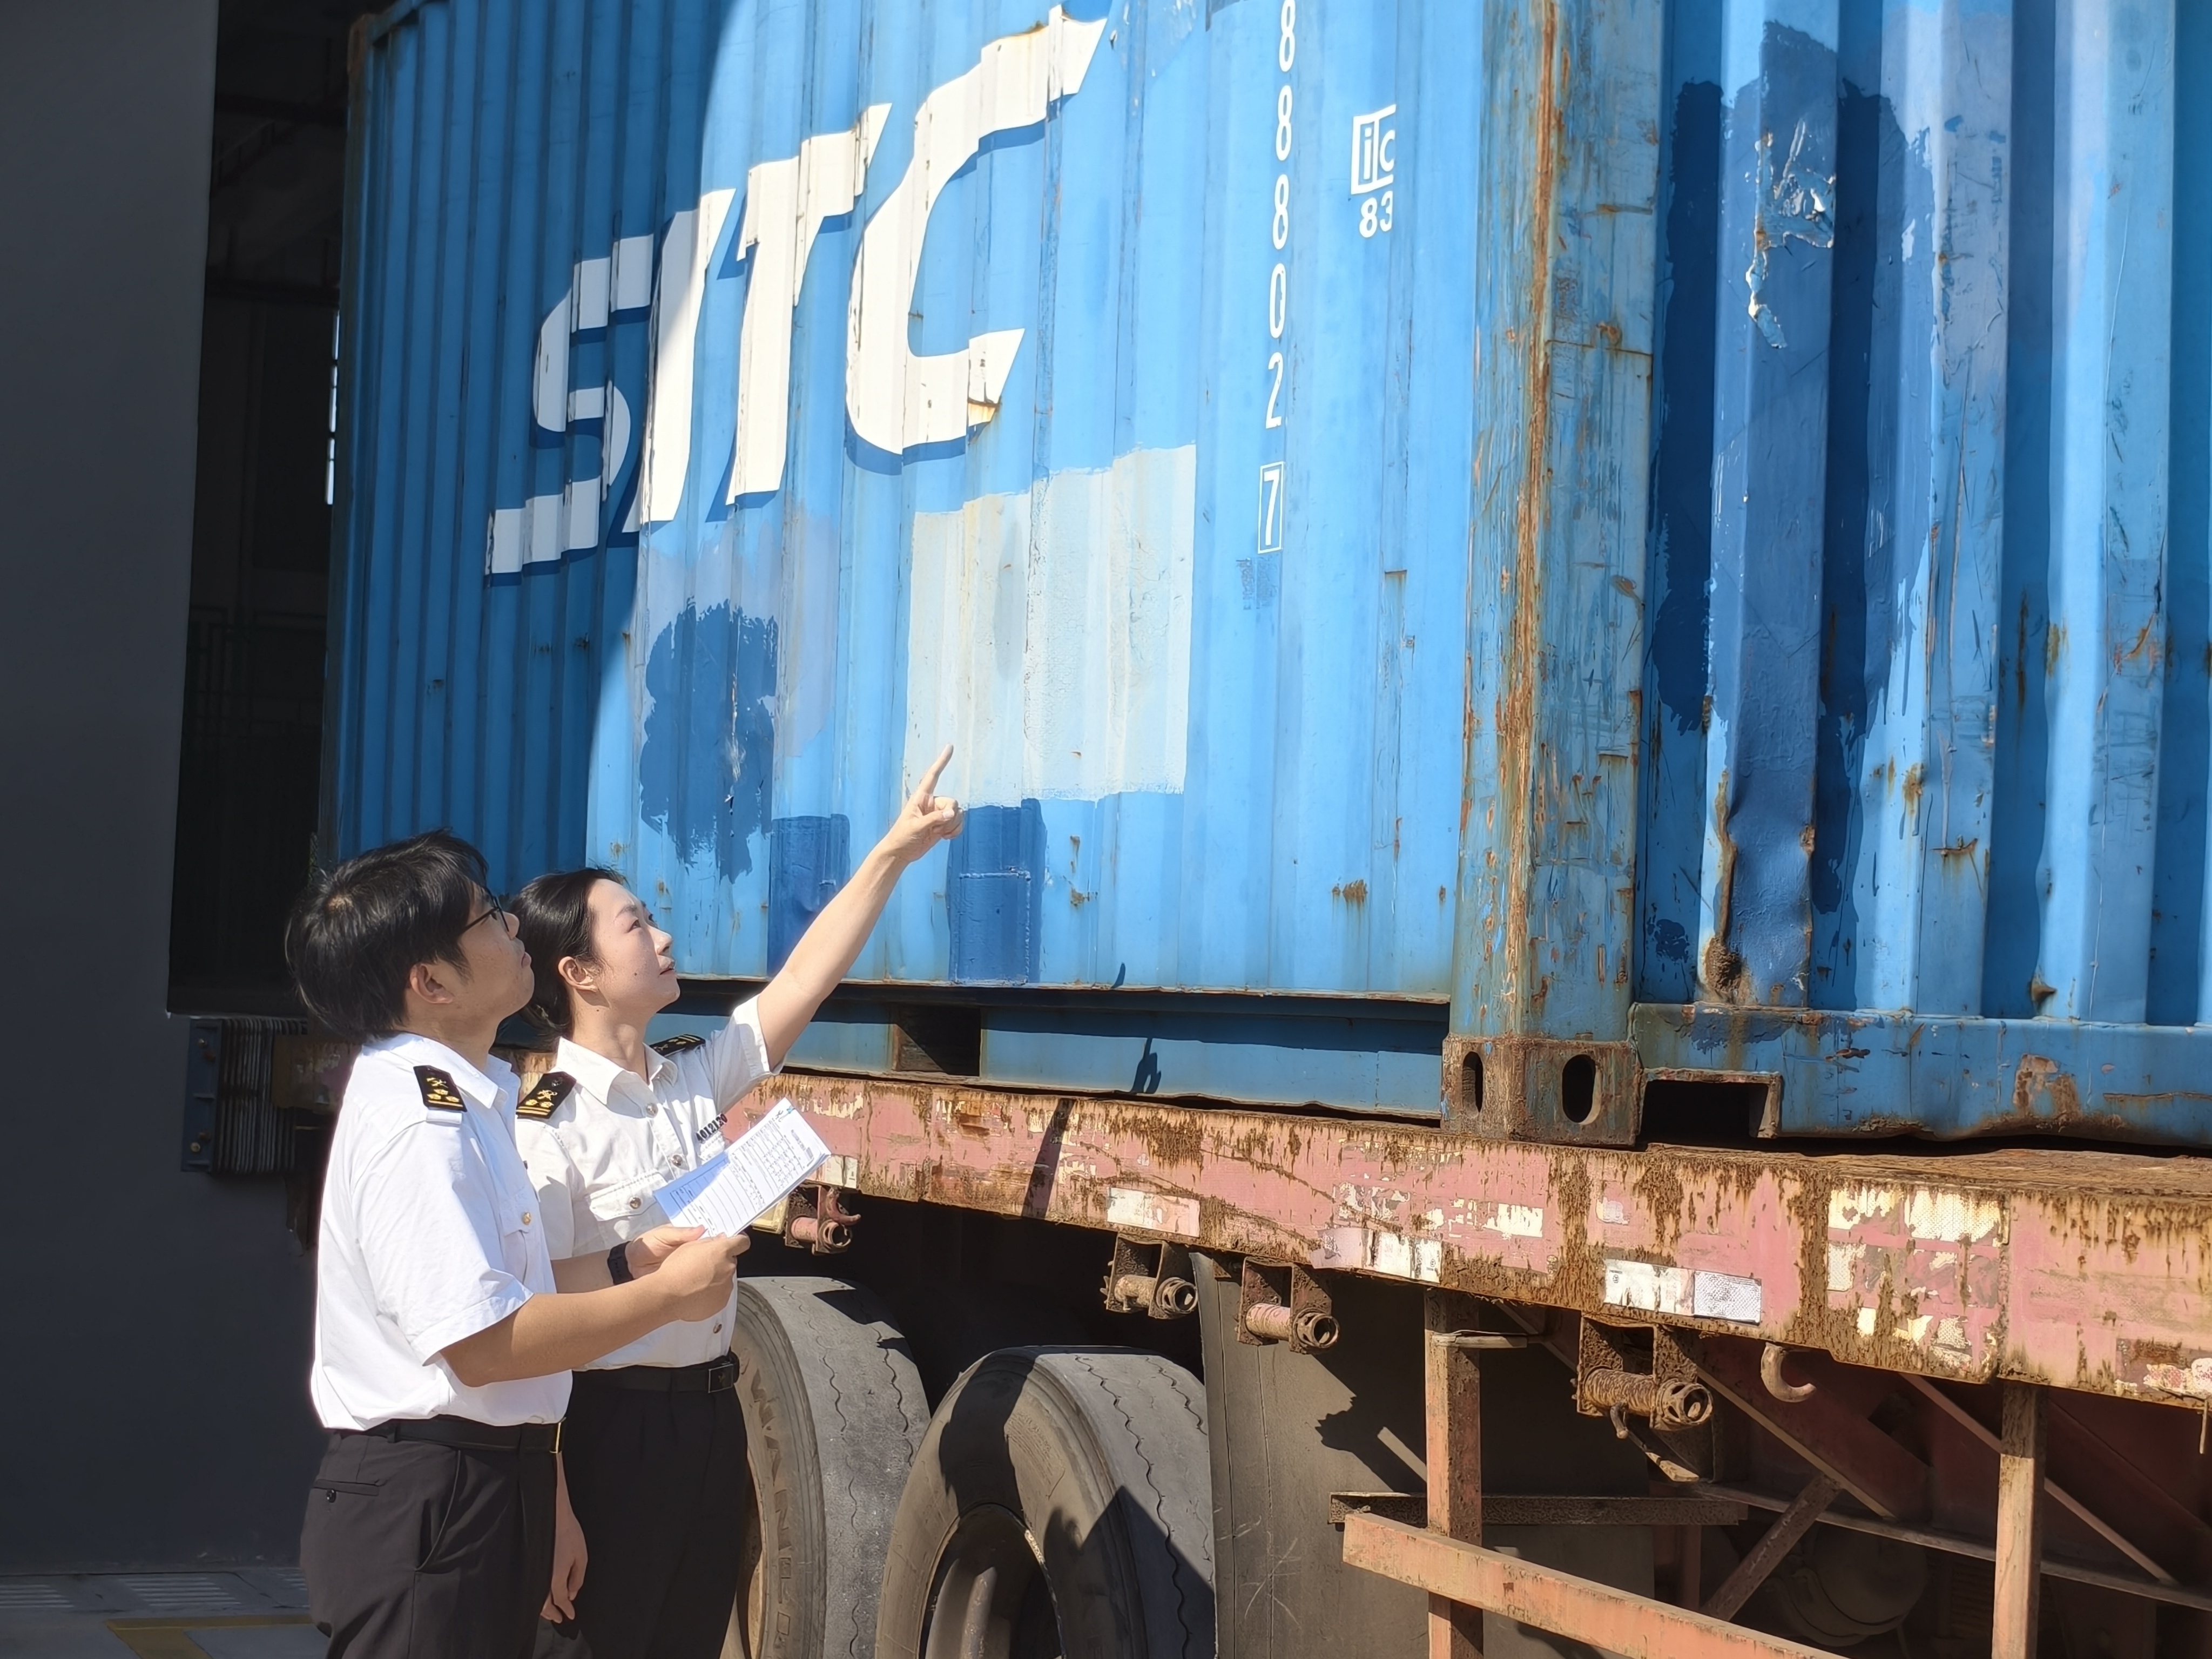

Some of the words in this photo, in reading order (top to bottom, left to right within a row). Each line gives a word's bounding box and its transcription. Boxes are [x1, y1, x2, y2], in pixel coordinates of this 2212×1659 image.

[1359, 190, 1393, 238] 83
[485, 4, 1108, 576] SITC
[1264, 469, 1280, 546] 7
